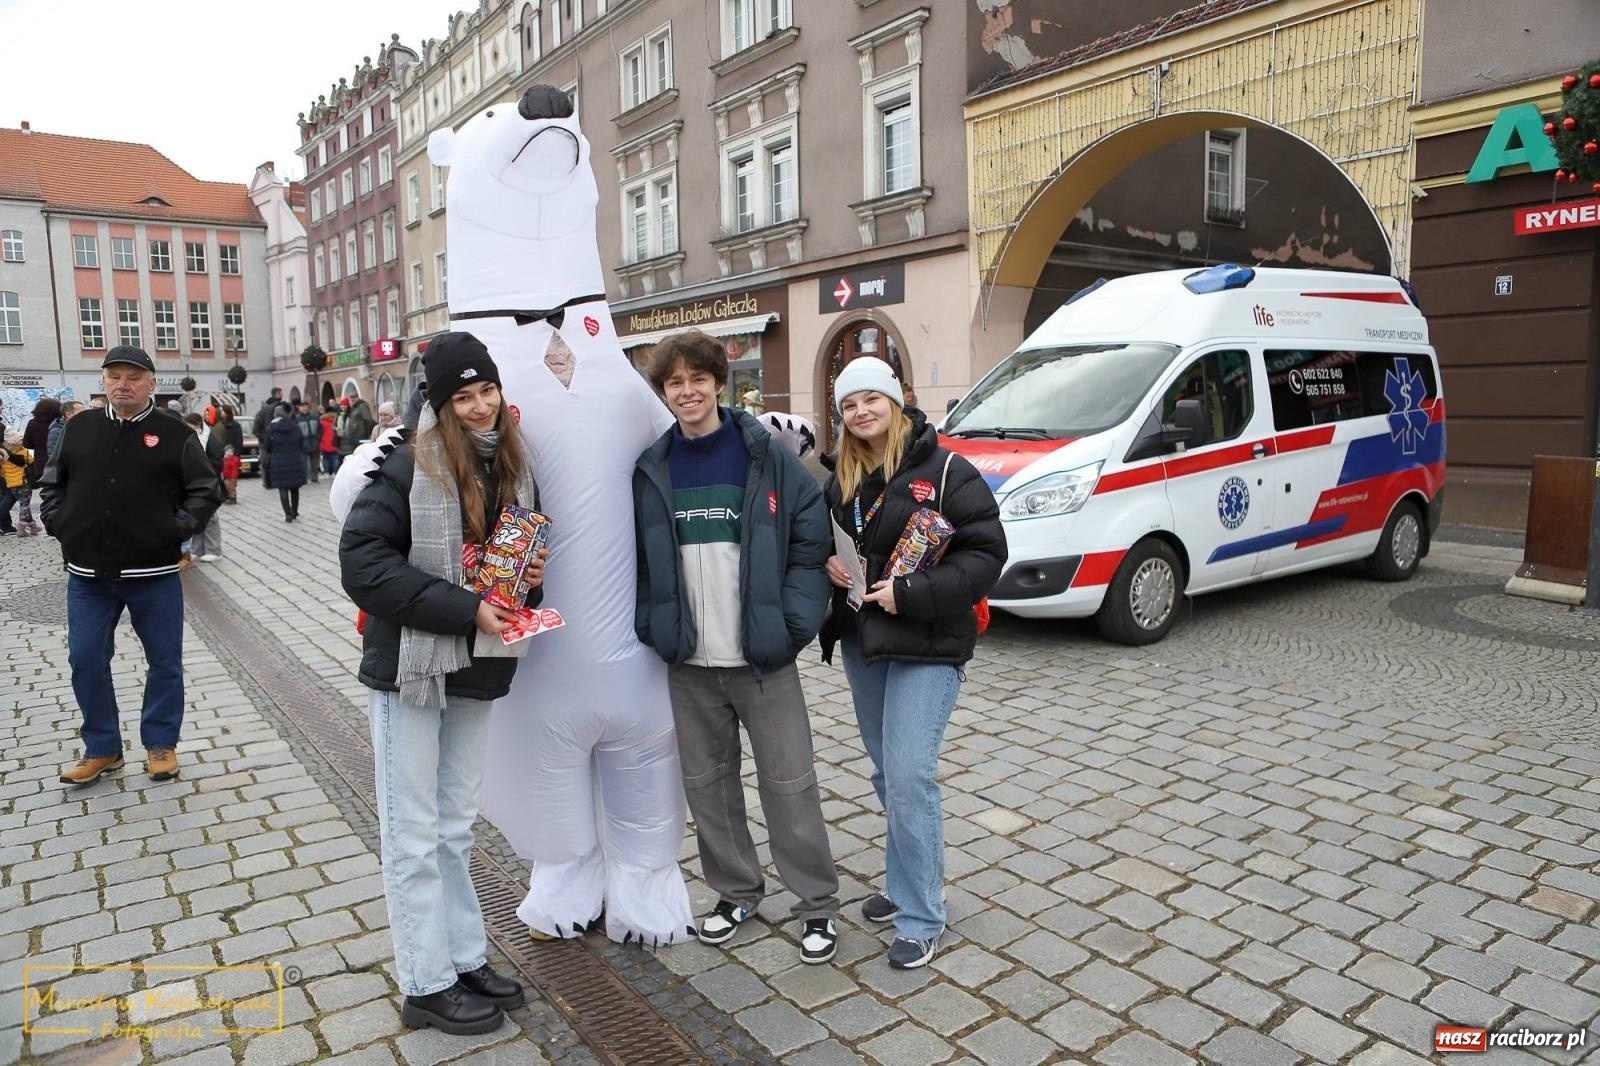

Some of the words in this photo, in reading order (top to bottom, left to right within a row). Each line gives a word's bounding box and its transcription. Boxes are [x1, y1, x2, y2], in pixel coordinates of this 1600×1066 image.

[1526, 204, 1600, 229] RYNE
[1498, 281, 1509, 294] 12
[680, 303, 711, 323] Lodów
[1253, 304, 1274, 327] life
[1364, 328, 1396, 339] TRANSPORT
[1302, 368, 1316, 380] 602
[1316, 368, 1330, 380] 622
[1330, 368, 1343, 379] 840
[1306, 384, 1319, 396] 505
[1320, 383, 1332, 395] 751
[1333, 383, 1345, 395] 858
[493, 526, 524, 547] 32
